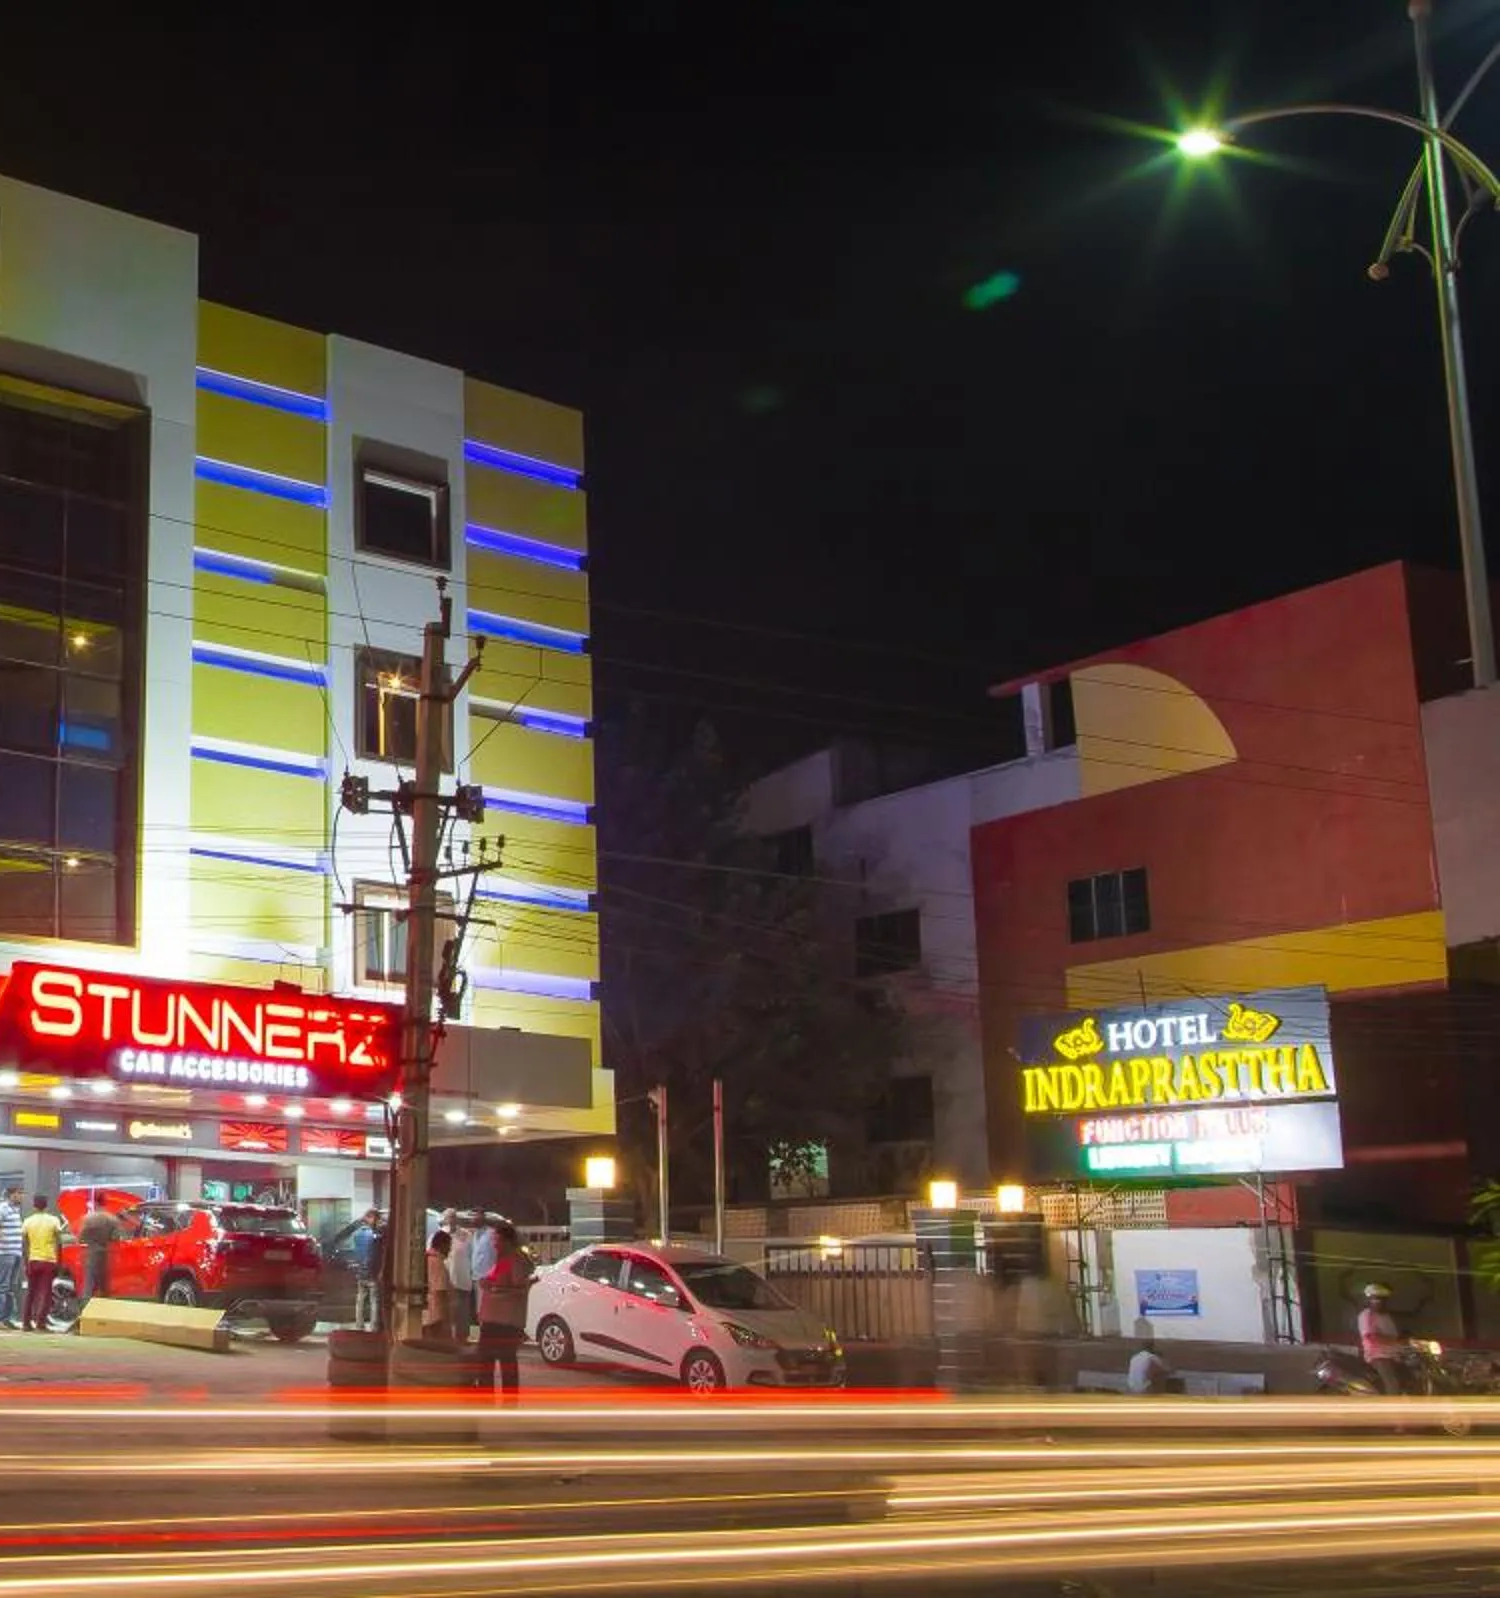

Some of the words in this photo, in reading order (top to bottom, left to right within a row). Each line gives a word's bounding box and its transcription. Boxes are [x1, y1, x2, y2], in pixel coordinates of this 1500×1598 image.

[1107, 1012, 1218, 1052] HOTEL
[119, 1049, 167, 1076] CAR
[169, 1055, 309, 1088] ACCESSORIES
[1022, 1043, 1329, 1113] INDRAPRASTTHA
